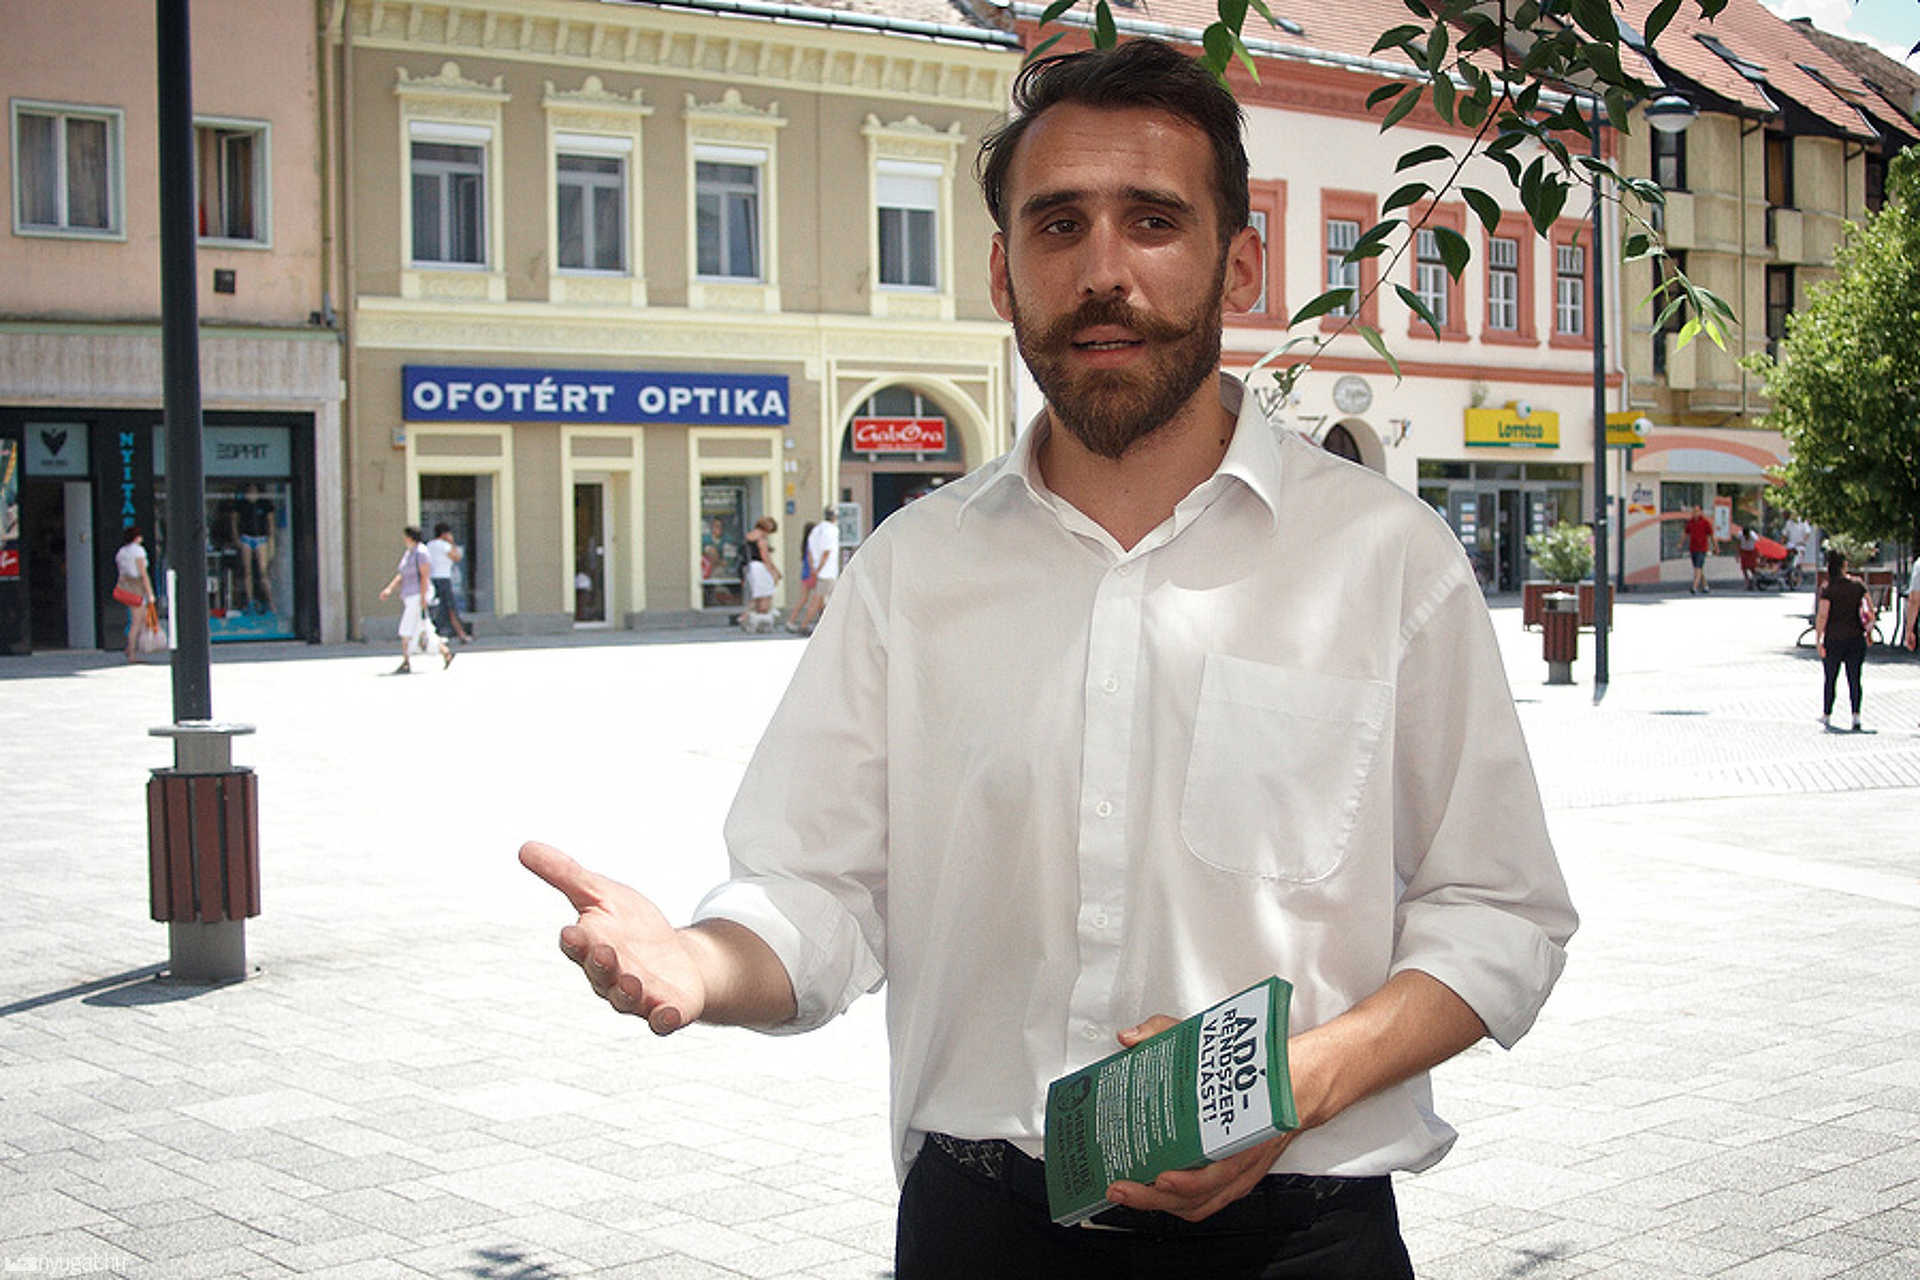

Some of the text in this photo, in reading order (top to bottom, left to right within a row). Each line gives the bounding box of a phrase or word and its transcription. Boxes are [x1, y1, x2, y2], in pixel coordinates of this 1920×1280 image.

[412, 377, 787, 418] OFOTÉRT OPTIKA
[215, 442, 270, 460] ESPRIT
[1200, 1018, 1220, 1124] VÁLTÁST!
[1217, 1008, 1238, 1135] RENDSZER-
[1232, 1015, 1267, 1110] ADÓ-
